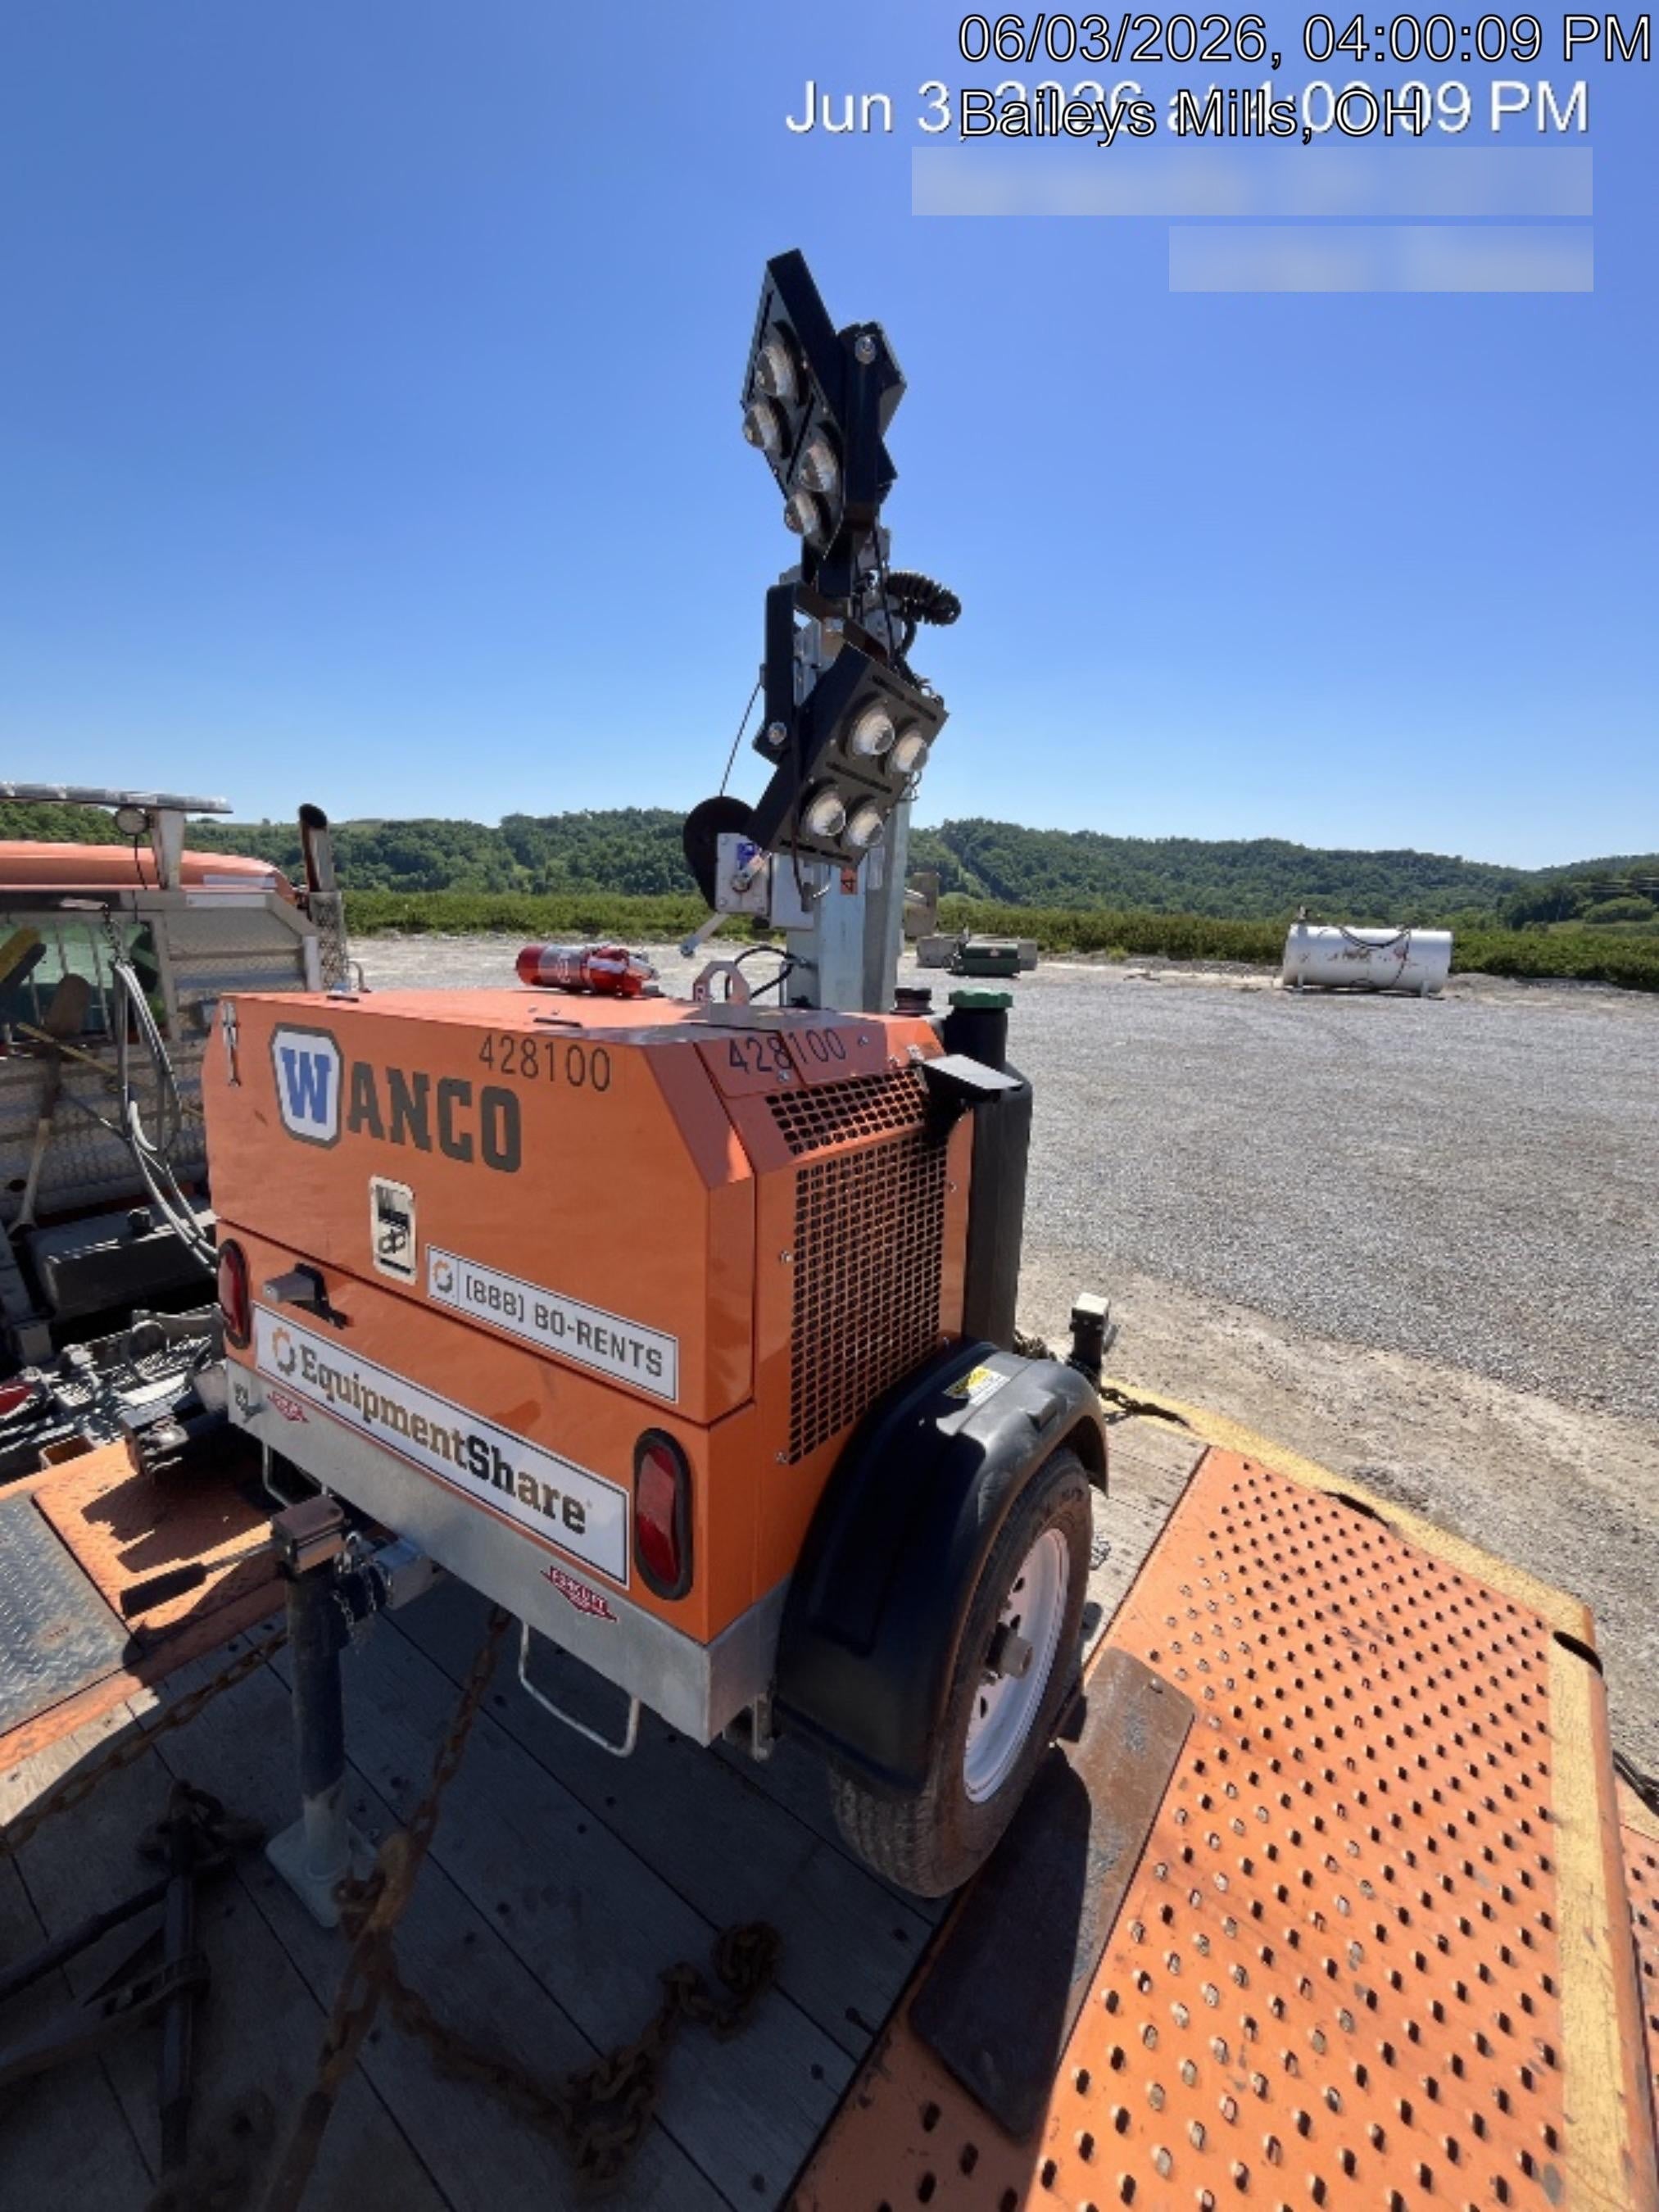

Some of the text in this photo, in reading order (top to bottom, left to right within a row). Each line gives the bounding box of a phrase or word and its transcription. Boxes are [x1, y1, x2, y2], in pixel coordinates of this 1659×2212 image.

[479, 1034, 610, 1093] 428100
[728, 1027, 846, 1074] 428100
[279, 1045, 522, 1173] WANCO
[299, 1343, 587, 1535] EquipmentShare
